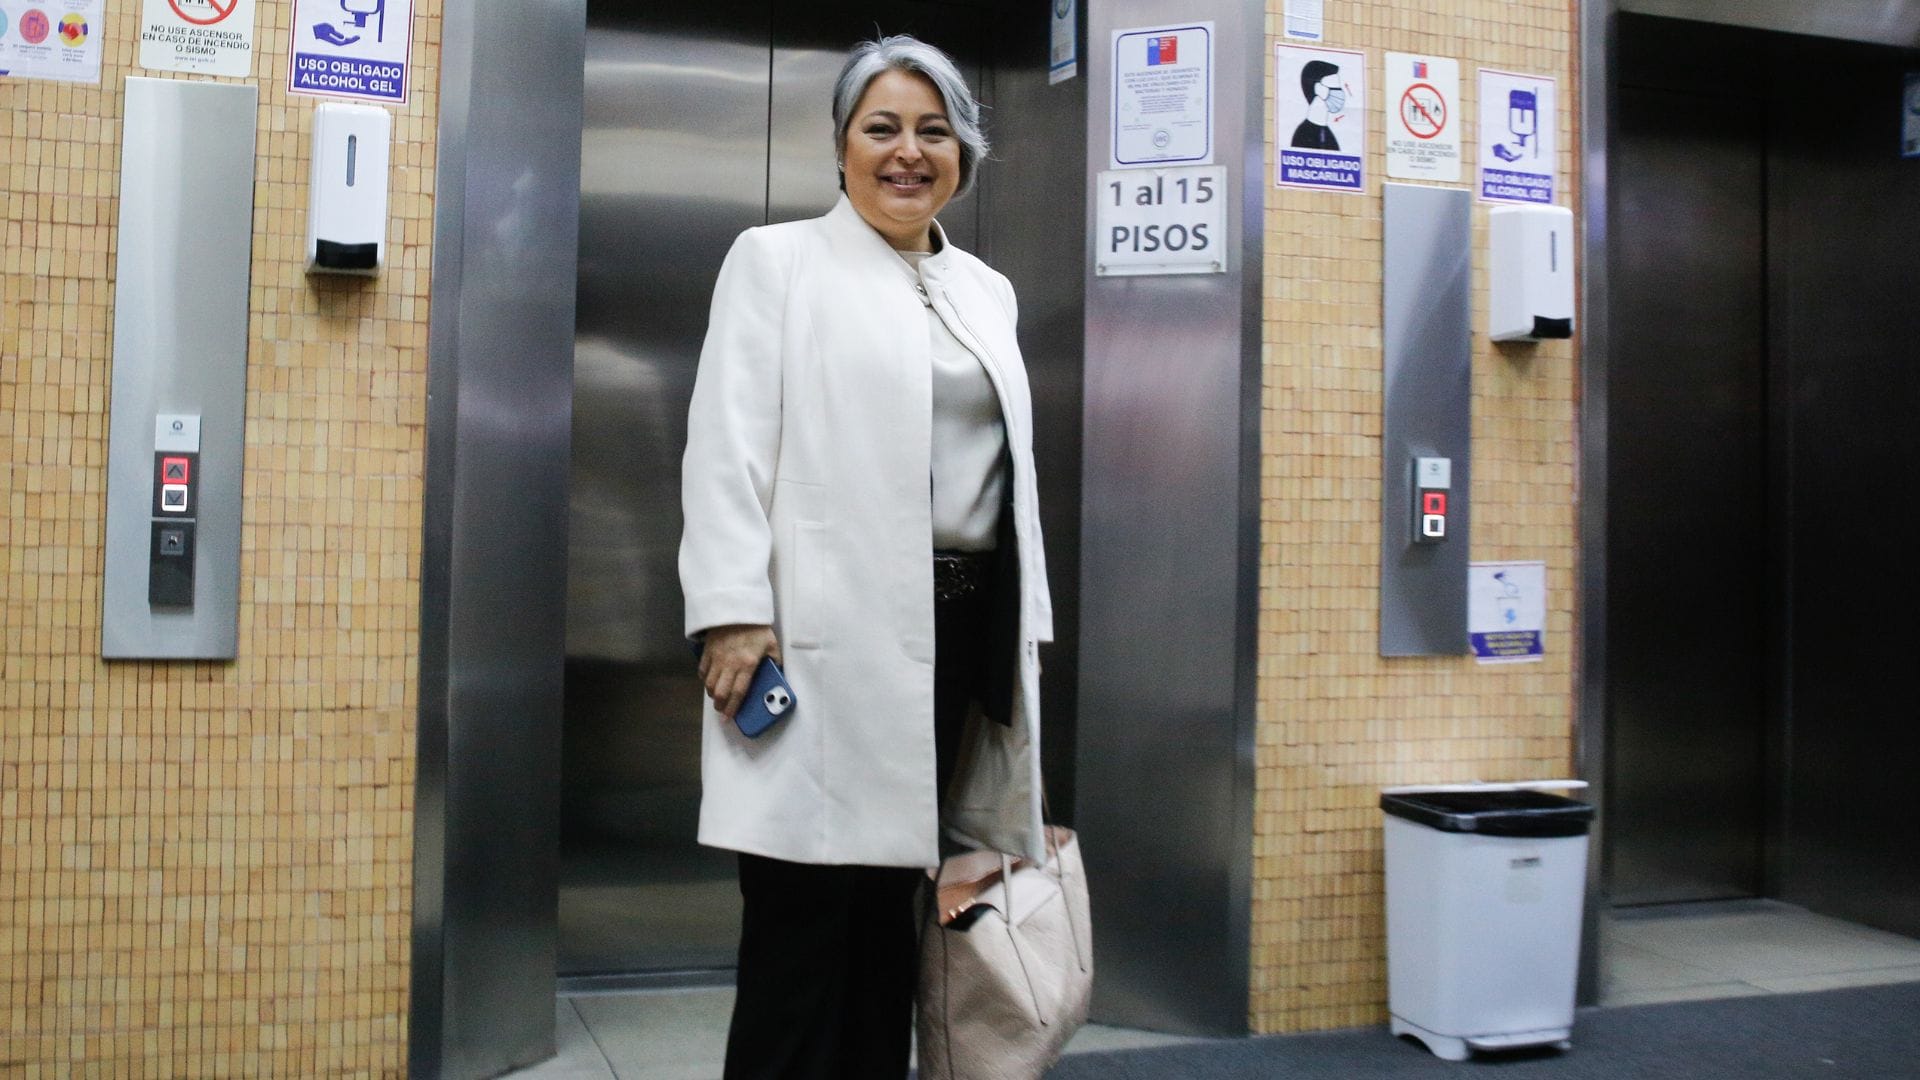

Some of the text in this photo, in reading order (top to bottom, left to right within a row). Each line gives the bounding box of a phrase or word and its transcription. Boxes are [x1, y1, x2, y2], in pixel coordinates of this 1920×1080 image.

[151, 24, 243, 40] NO USE ASCENSOR
[158, 34, 186, 43] CASO
[188, 37, 201, 45] DE
[204, 38, 250, 50] INCENDIO
[186, 45, 216, 55] SISMO
[298, 58, 401, 79] USO OBLIGADO
[301, 73, 396, 93] ALCOHOL GEL
[1282, 155, 1360, 171] USO OBLIGADO
[1288, 168, 1355, 183] MASCARILLA
[1484, 172, 1552, 188] USO OBLIGADO
[1110, 176, 1213, 206] 1 al 15
[1485, 184, 1549, 200] ALCOHOL GEL
[1111, 223, 1209, 253] PISOS
